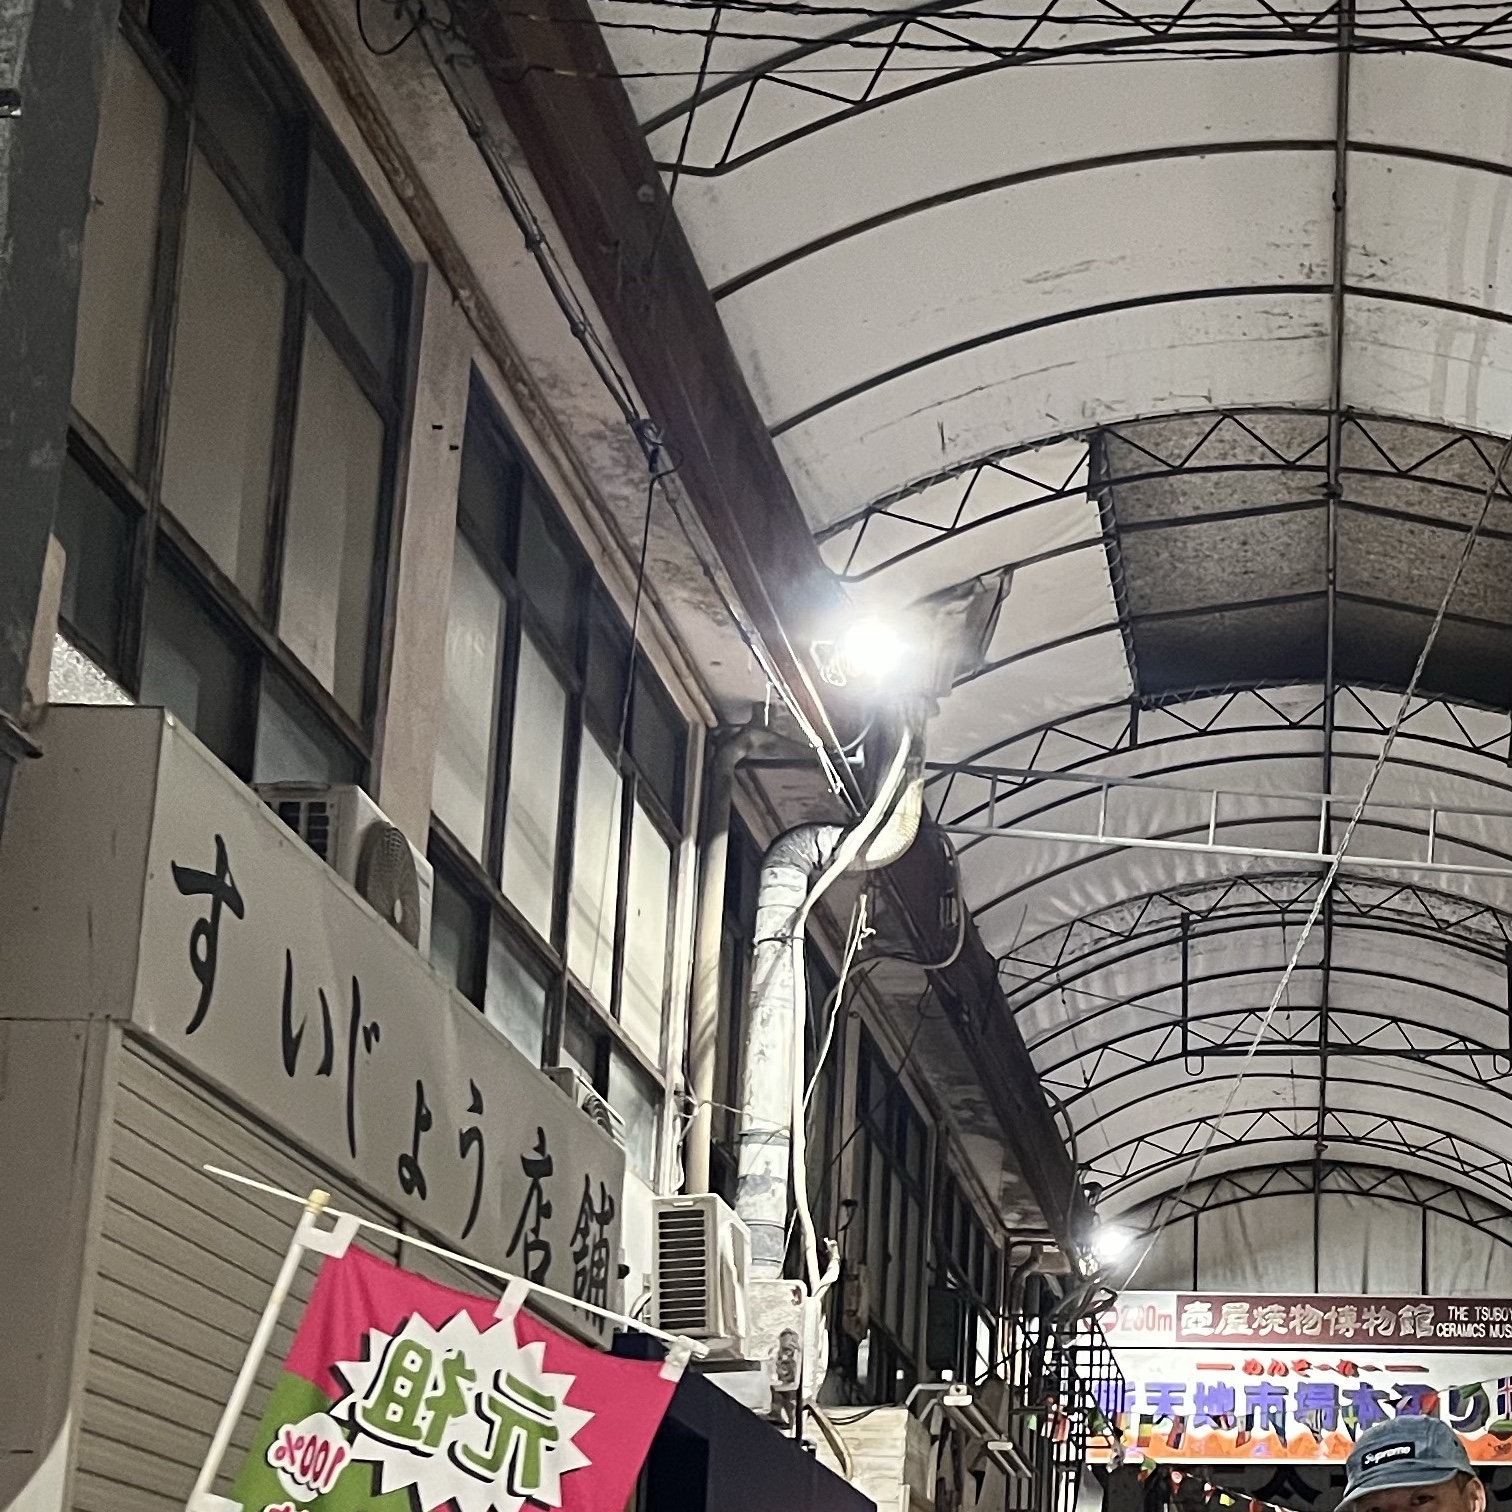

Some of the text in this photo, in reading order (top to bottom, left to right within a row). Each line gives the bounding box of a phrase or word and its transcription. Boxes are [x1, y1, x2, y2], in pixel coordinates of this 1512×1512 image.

[171, 833, 615, 1336] すいじょう店舗
[1447, 1306, 1469, 1322] THE
[1436, 1322, 1487, 1339] CERAMICS
